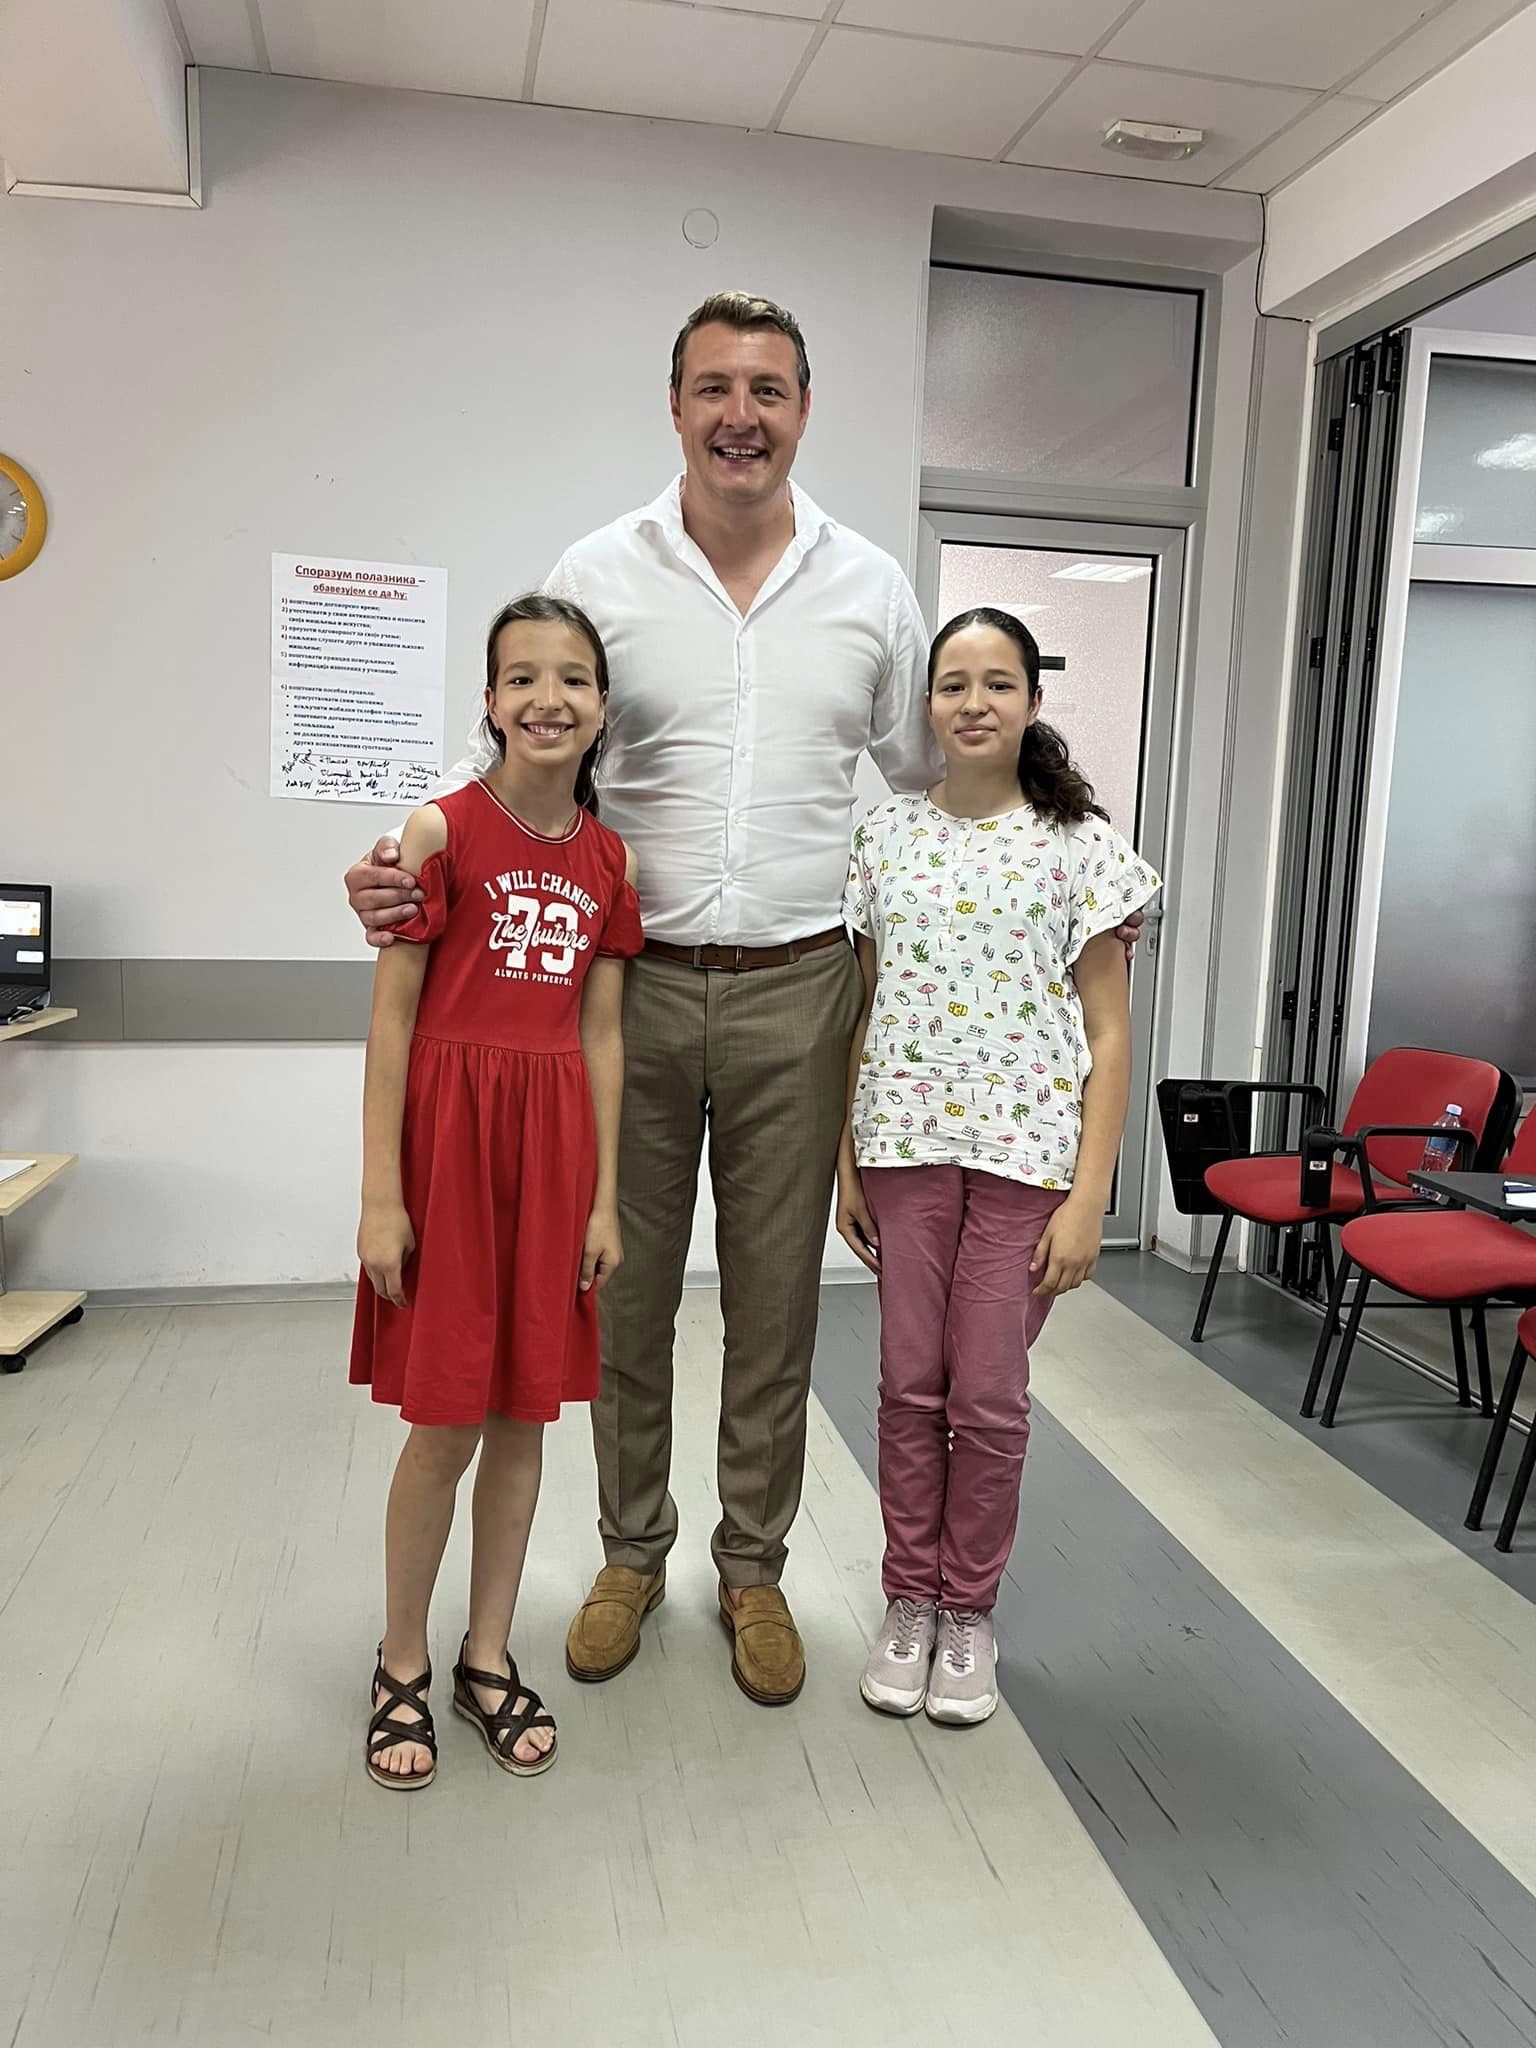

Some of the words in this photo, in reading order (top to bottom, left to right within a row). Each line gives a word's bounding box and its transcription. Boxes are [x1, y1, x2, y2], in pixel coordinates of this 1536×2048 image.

[295, 565, 353, 580] Споразум
[355, 571, 416, 585] полазника
[313, 583, 366, 597] обавезујем
[368, 589, 378, 597] се
[379, 589, 392, 598] да
[484, 881, 498, 900] I
[496, 870, 537, 894] WILL
[541, 872, 600, 919] CHANGE
[489, 912, 529, 951] The
[531, 922, 590, 952] future
[506, 894, 579, 975] 73
[495, 968, 529, 980] ALWAYS
[532, 972, 573, 986] POWERFUL
